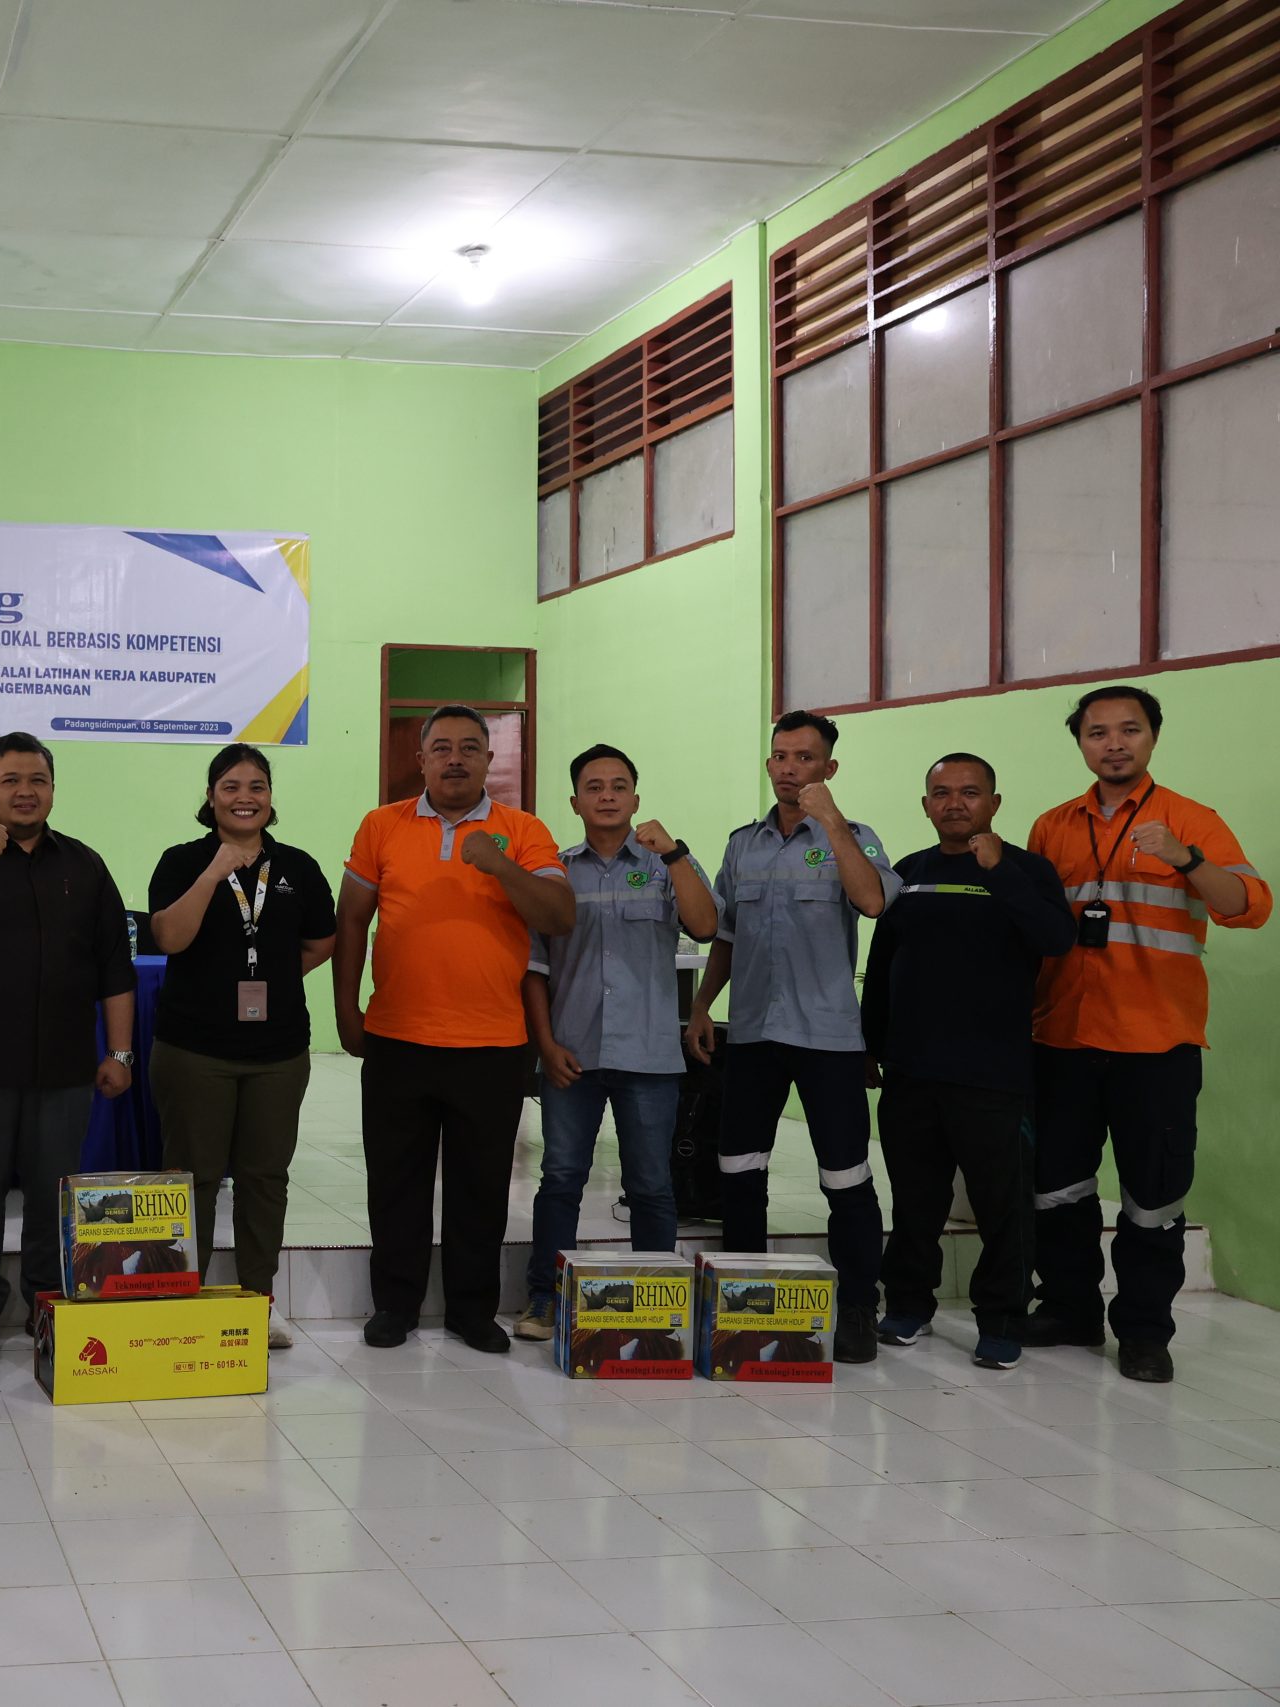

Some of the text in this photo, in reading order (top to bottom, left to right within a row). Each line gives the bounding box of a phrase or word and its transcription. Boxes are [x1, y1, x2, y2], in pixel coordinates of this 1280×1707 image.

[47, 631, 120, 650] BERBASIS
[126, 634, 221, 653] KOMPETENSI
[35, 668, 90, 680] LATIHAN
[94, 669, 136, 682] KERJA
[140, 670, 216, 684] KABUPATEN
[64, 719, 219, 732] Padangsidimpuan, 08 September 2023
[134, 1192, 187, 1216] RHINO
[78, 1226, 165, 1236] GARANSI SERVICE SEUMUR HIDUP
[114, 1280, 192, 1290] Teknologi Inverter
[635, 1286, 686, 1307] RHINO
[776, 1288, 829, 1310] RHINO
[579, 1315, 602, 1323] GARANSI
[603, 1315, 625, 1323] SERVICE
[719, 1316, 742, 1324] GARANSI
[743, 1317, 765, 1325] SERVICE
[766, 1317, 788, 1325] SEUMUR
[72, 1366, 118, 1376] MASSAKI
[611, 1367, 650, 1375] Teknologi
[751, 1367, 826, 1376] Teknologi Inverter
